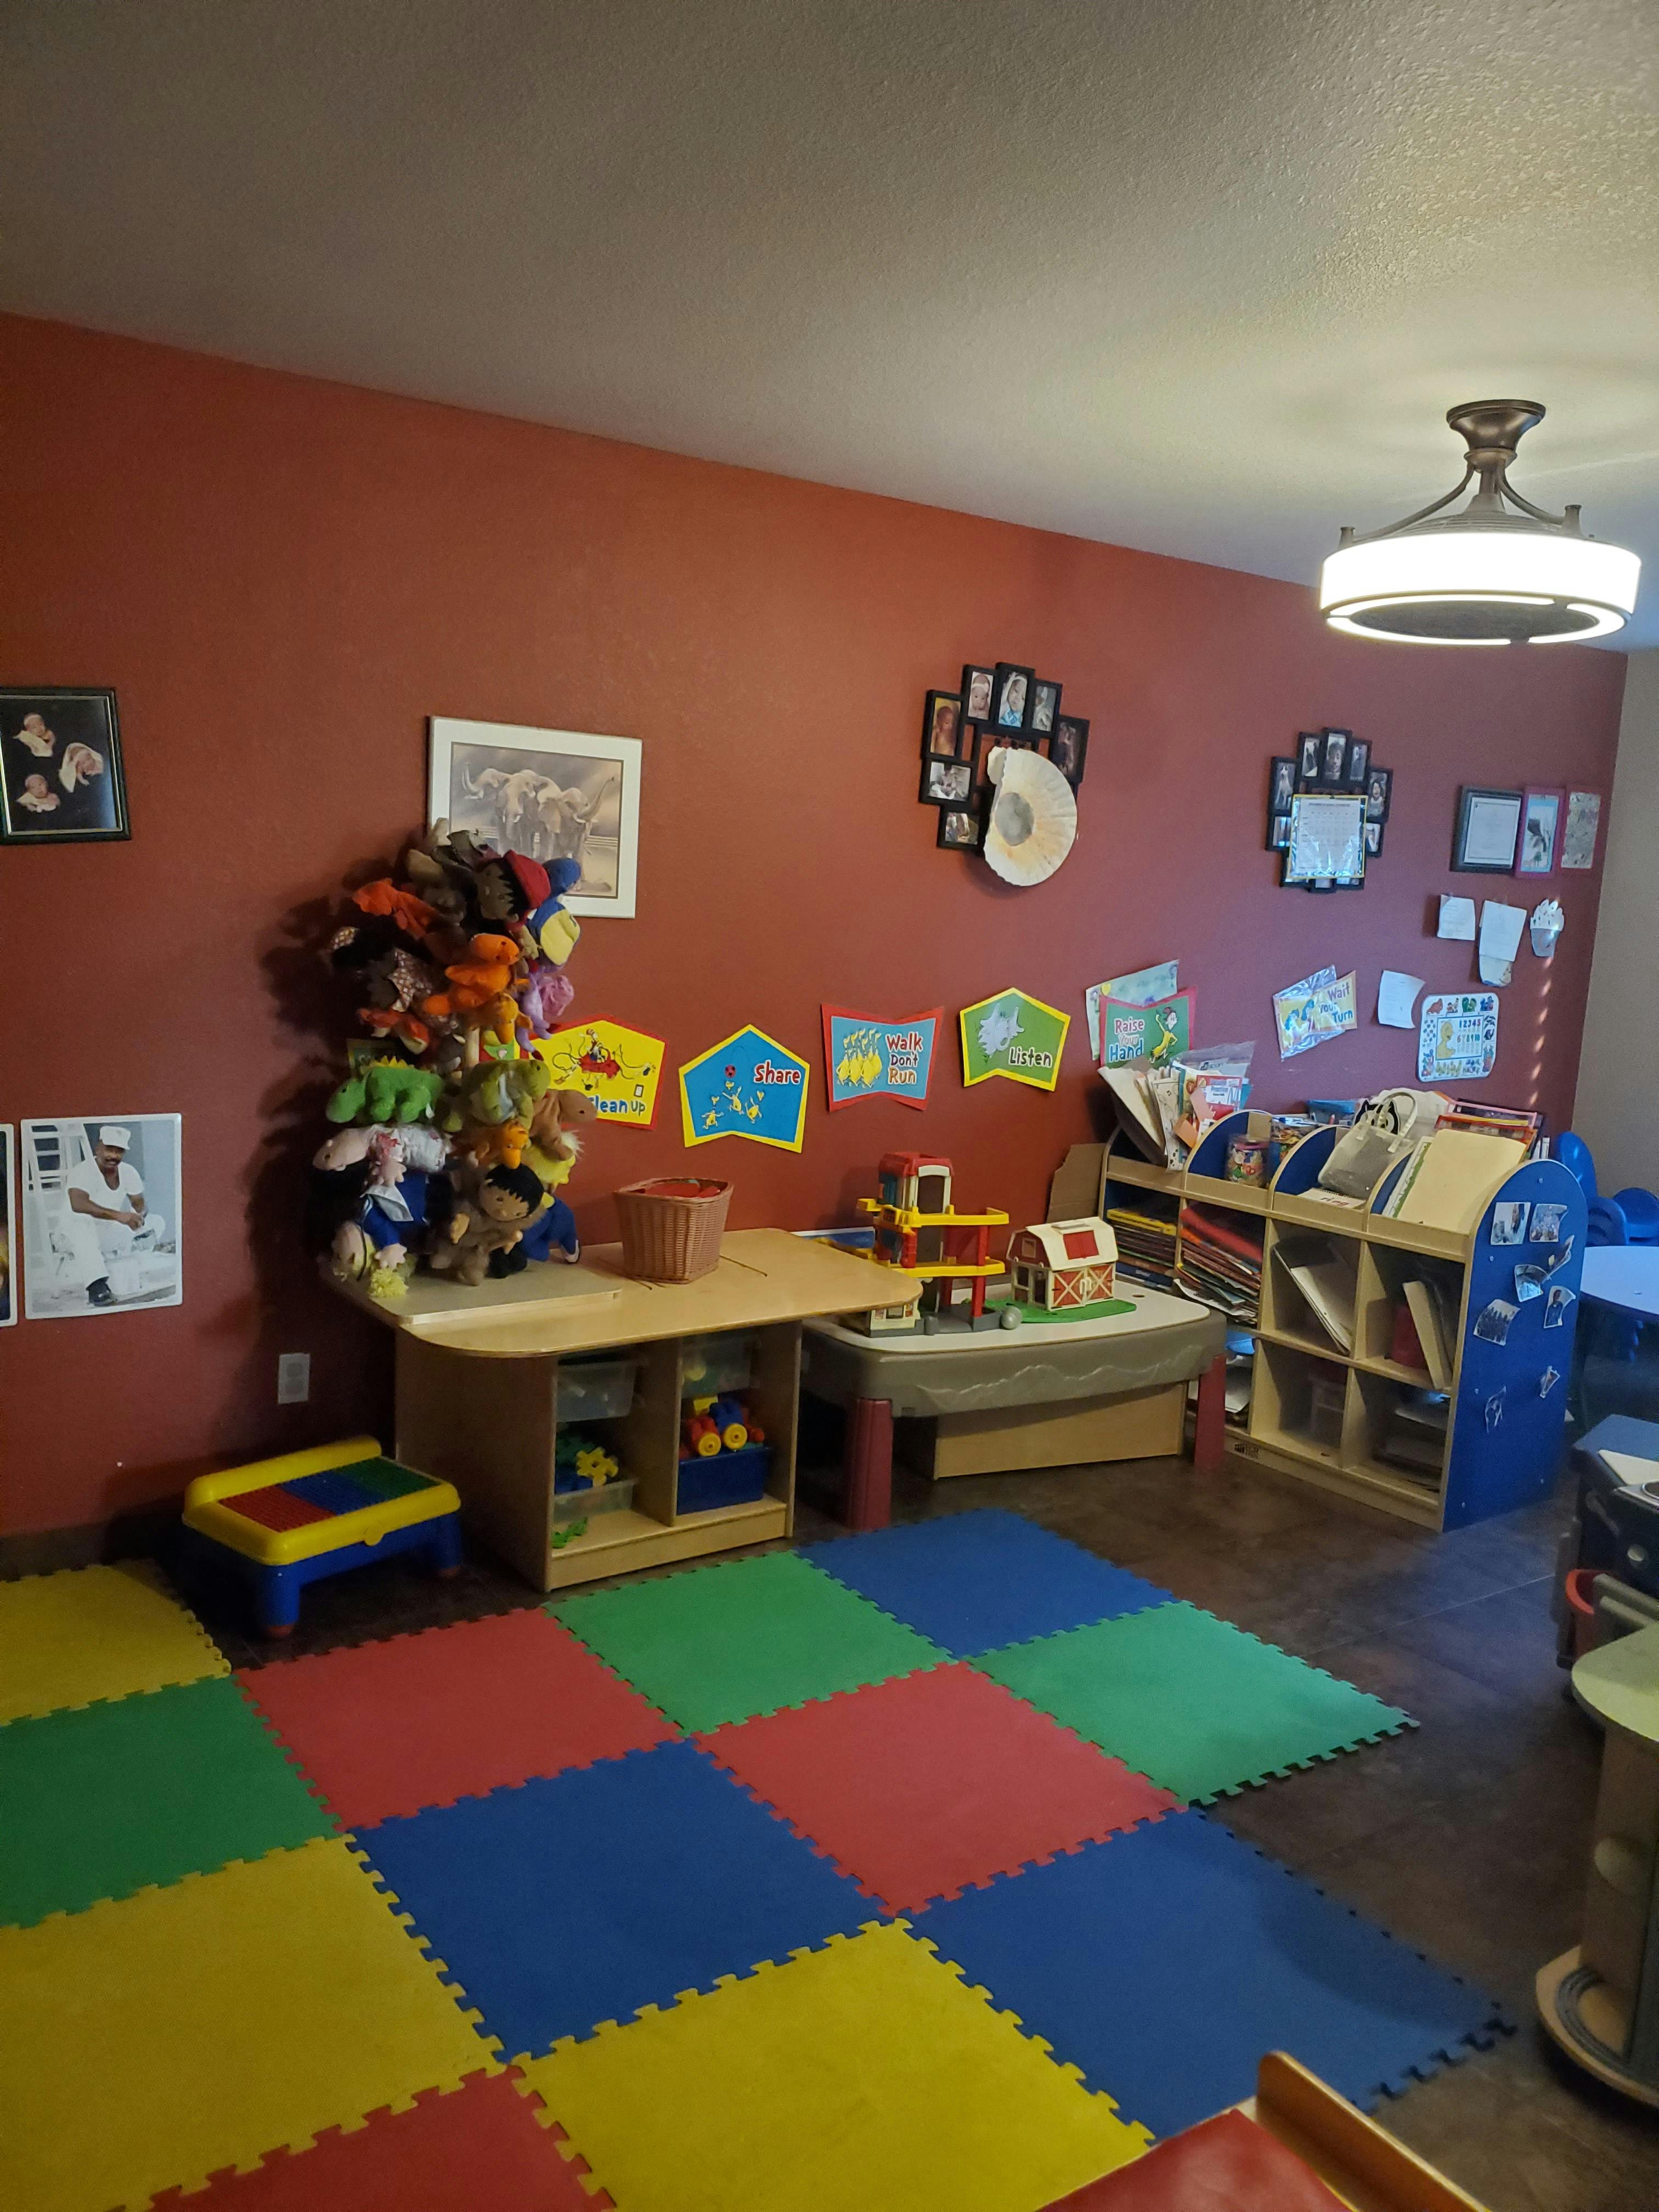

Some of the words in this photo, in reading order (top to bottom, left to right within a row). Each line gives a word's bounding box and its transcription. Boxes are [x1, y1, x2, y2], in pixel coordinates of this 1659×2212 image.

[1328, 981, 1350, 1001] Wait
[1115, 1017, 1144, 1034] Raise
[1331, 1010, 1353, 1023] Turn
[886, 1032, 922, 1051] Walk
[1119, 1035, 1138, 1046] Your
[890, 1052, 918, 1066] Don't
[1009, 1047, 1051, 1067] Listen
[1110, 1039, 1143, 1062] Hand
[754, 1060, 800, 1084] Share
[889, 1068, 916, 1084] Run
